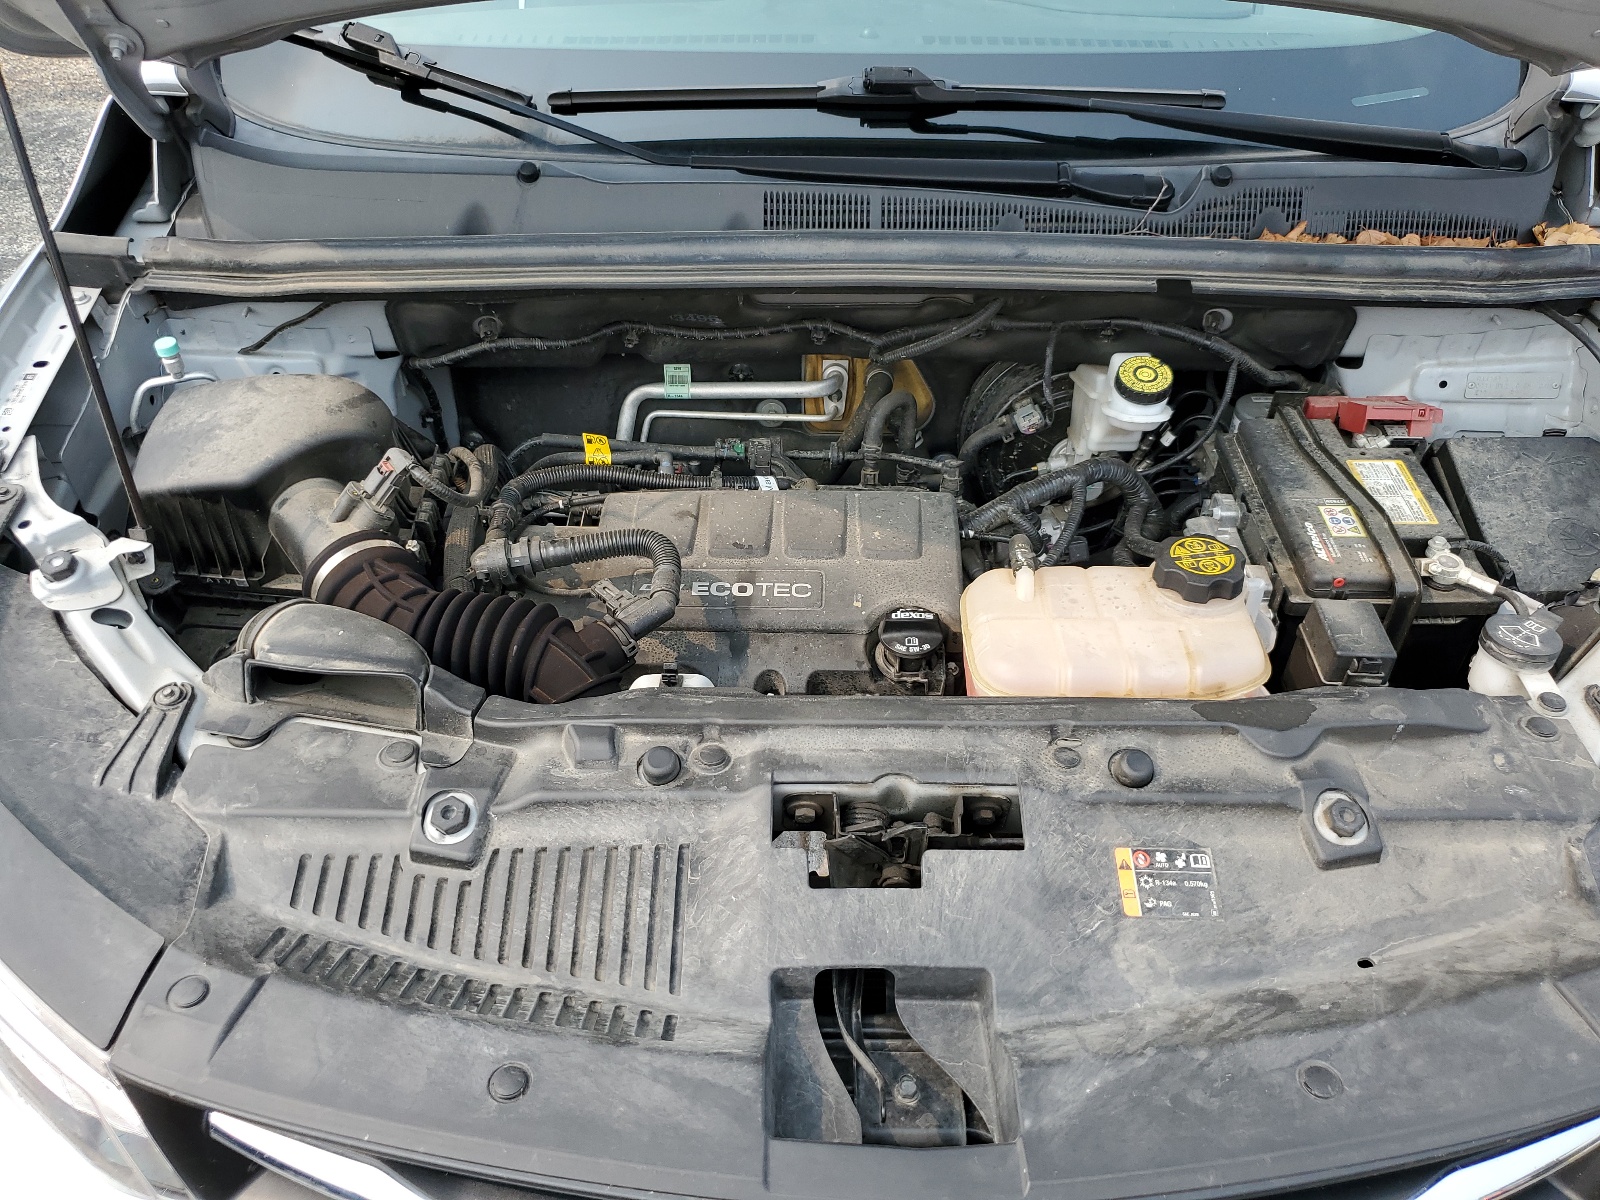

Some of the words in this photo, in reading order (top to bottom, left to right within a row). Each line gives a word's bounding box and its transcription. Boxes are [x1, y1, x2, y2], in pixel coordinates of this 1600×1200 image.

[691, 581, 812, 598] ECOTEC
[891, 610, 934, 620] dexos
[894, 643, 908, 652] SAE
[908, 643, 931, 653] 5W-30
[1159, 900, 1173, 908] PAG
